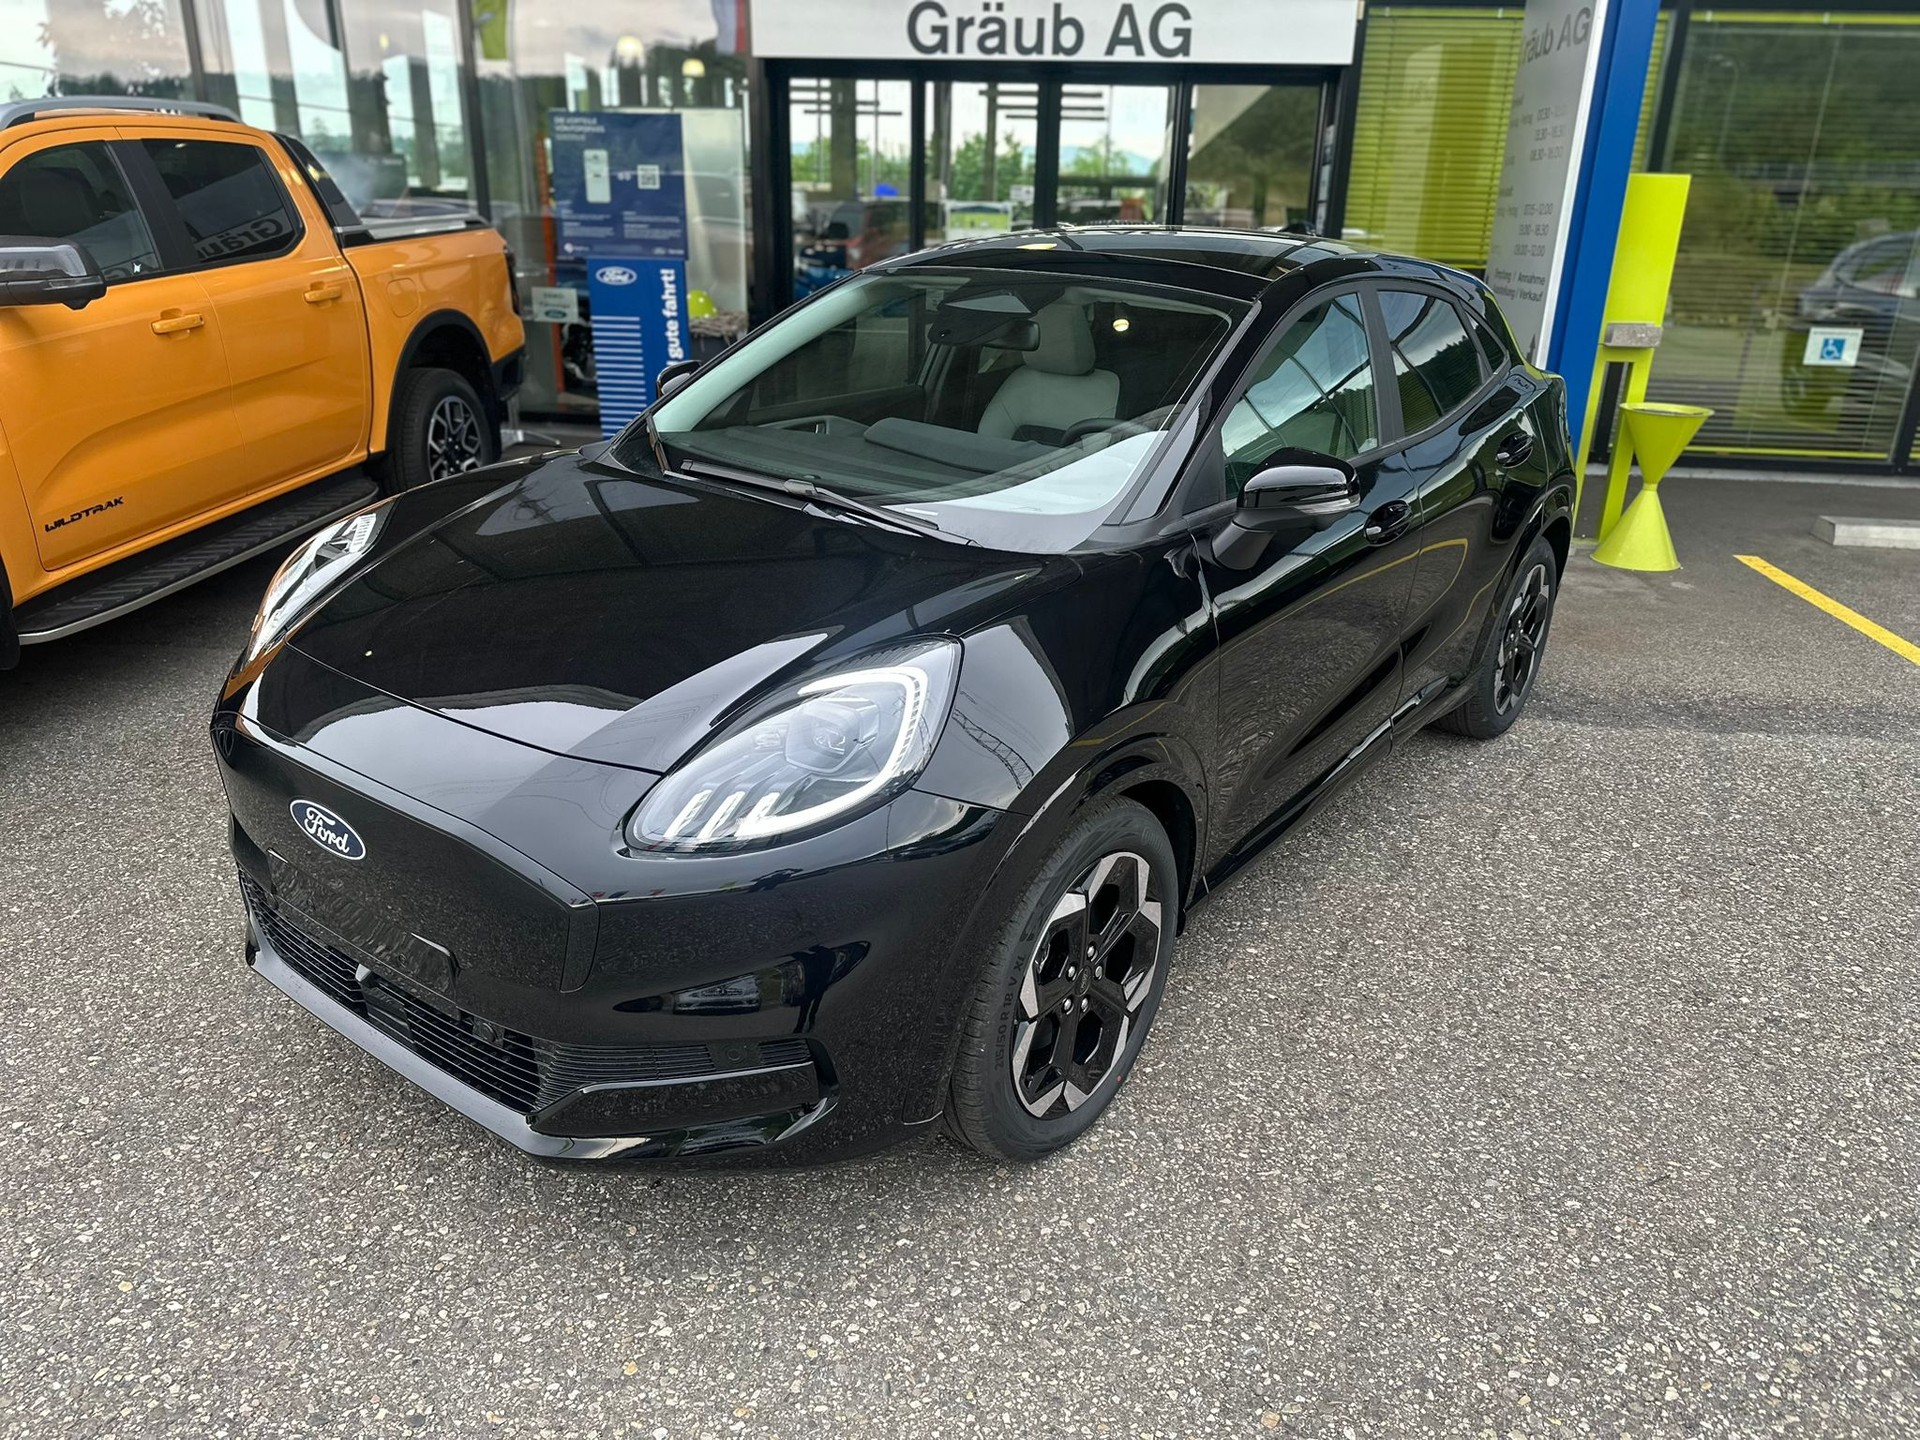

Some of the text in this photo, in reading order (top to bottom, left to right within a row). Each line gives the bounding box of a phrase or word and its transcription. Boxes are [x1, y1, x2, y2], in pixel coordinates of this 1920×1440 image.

[907, 0, 1193, 58] Gräub AG
[1521, 6, 1592, 65] räub AG
[659, 268, 679, 318] fahrt!
[1518, 271, 1546, 285] Annahme
[1519, 289, 1545, 302] Verkauf
[665, 319, 684, 360] gute
[45, 496, 124, 532] WILDTRAK
[304, 807, 350, 853] Ford
[1003, 992, 1014, 1008] 18
